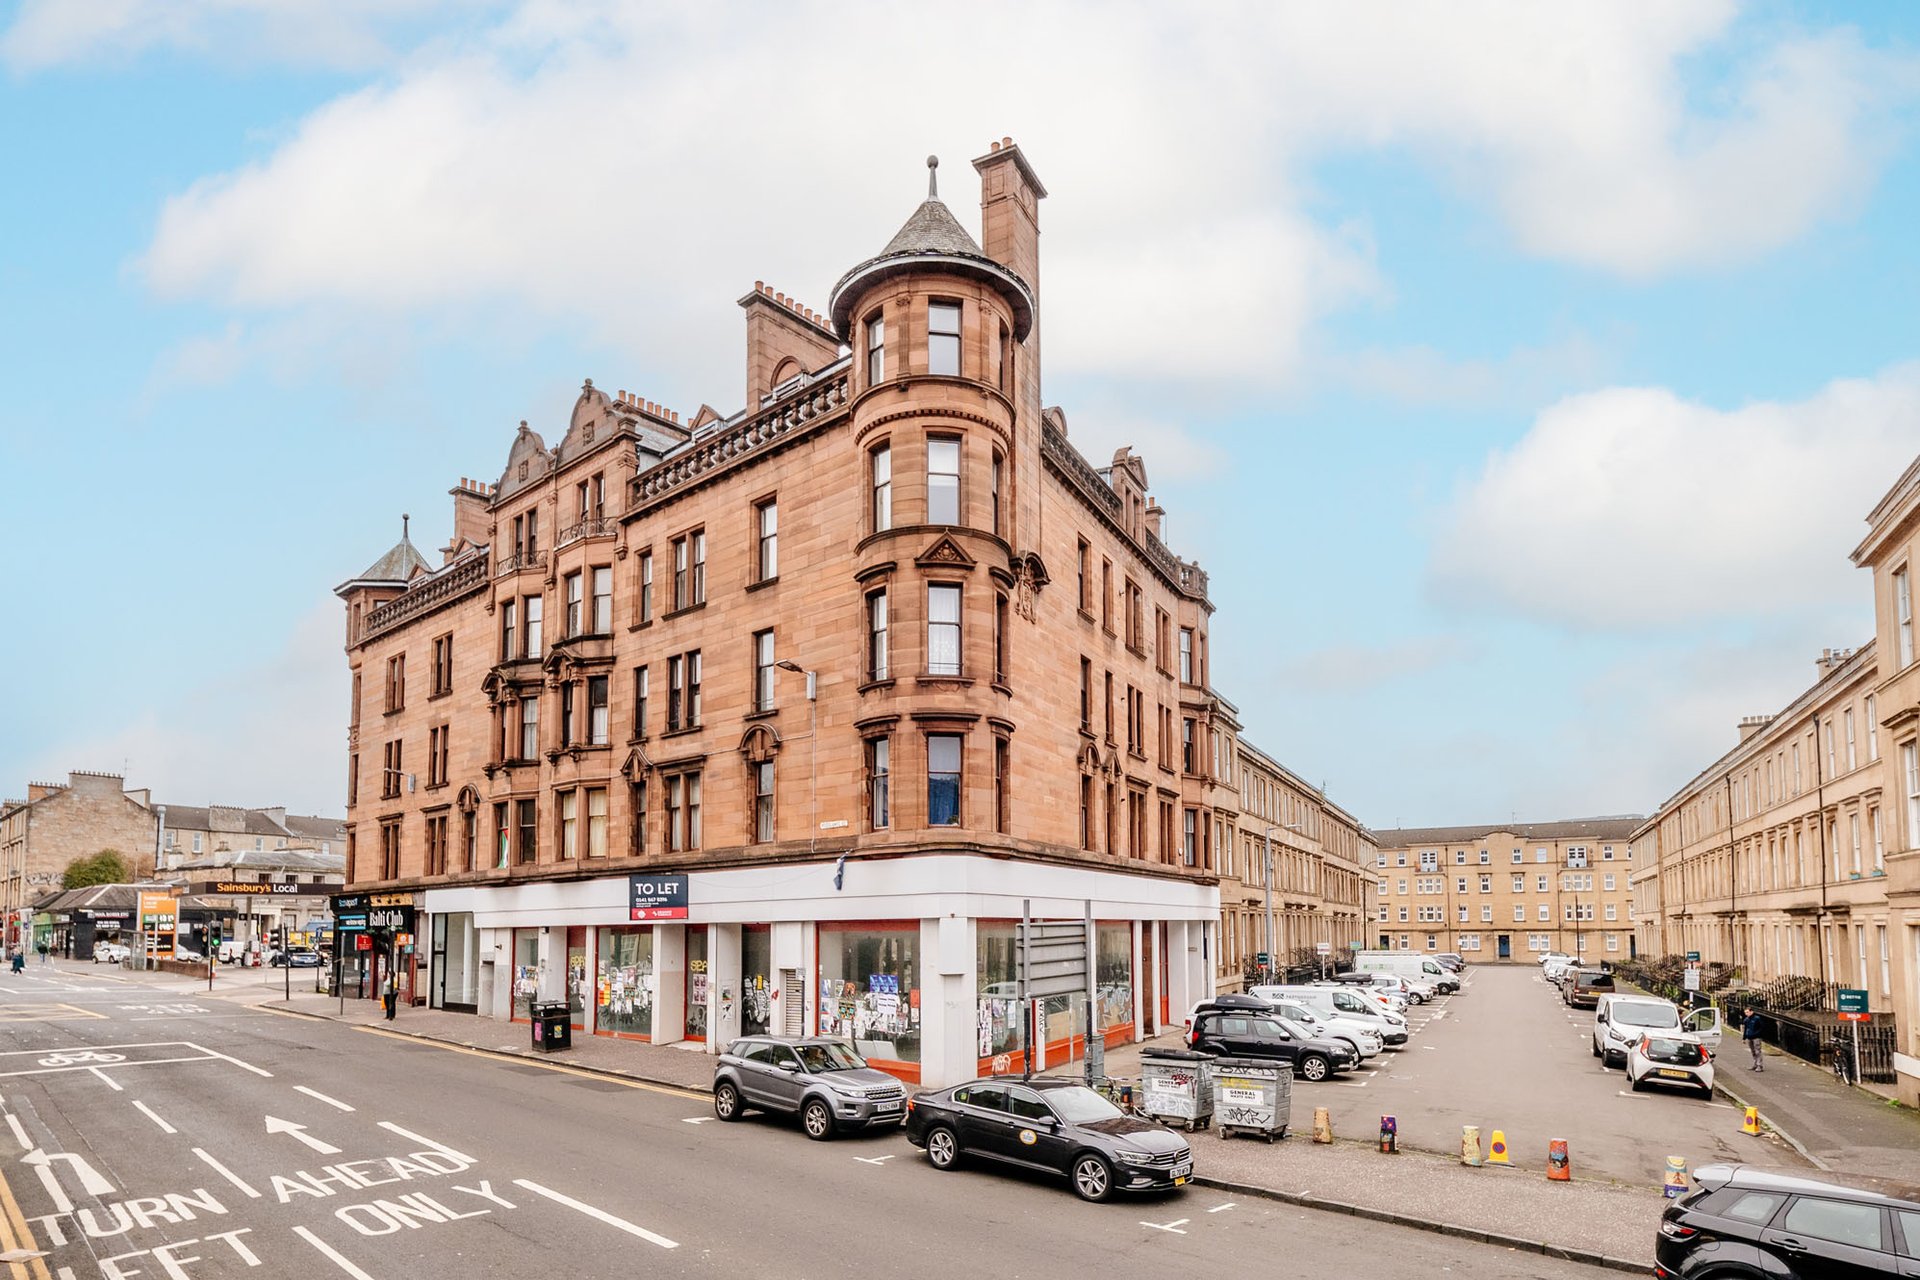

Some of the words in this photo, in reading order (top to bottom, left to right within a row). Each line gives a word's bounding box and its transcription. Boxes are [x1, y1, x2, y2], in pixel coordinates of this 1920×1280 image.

[217, 883, 271, 894] Sainsbury's
[273, 884, 298, 893] Local
[635, 883, 654, 895] TO
[658, 883, 679, 894] LET
[369, 911, 386, 926] Balti
[386, 910, 404, 926] Club
[270, 1151, 470, 1203] AHEAD
[26, 1188, 229, 1246] TURN
[335, 1180, 517, 1236] ONLY
